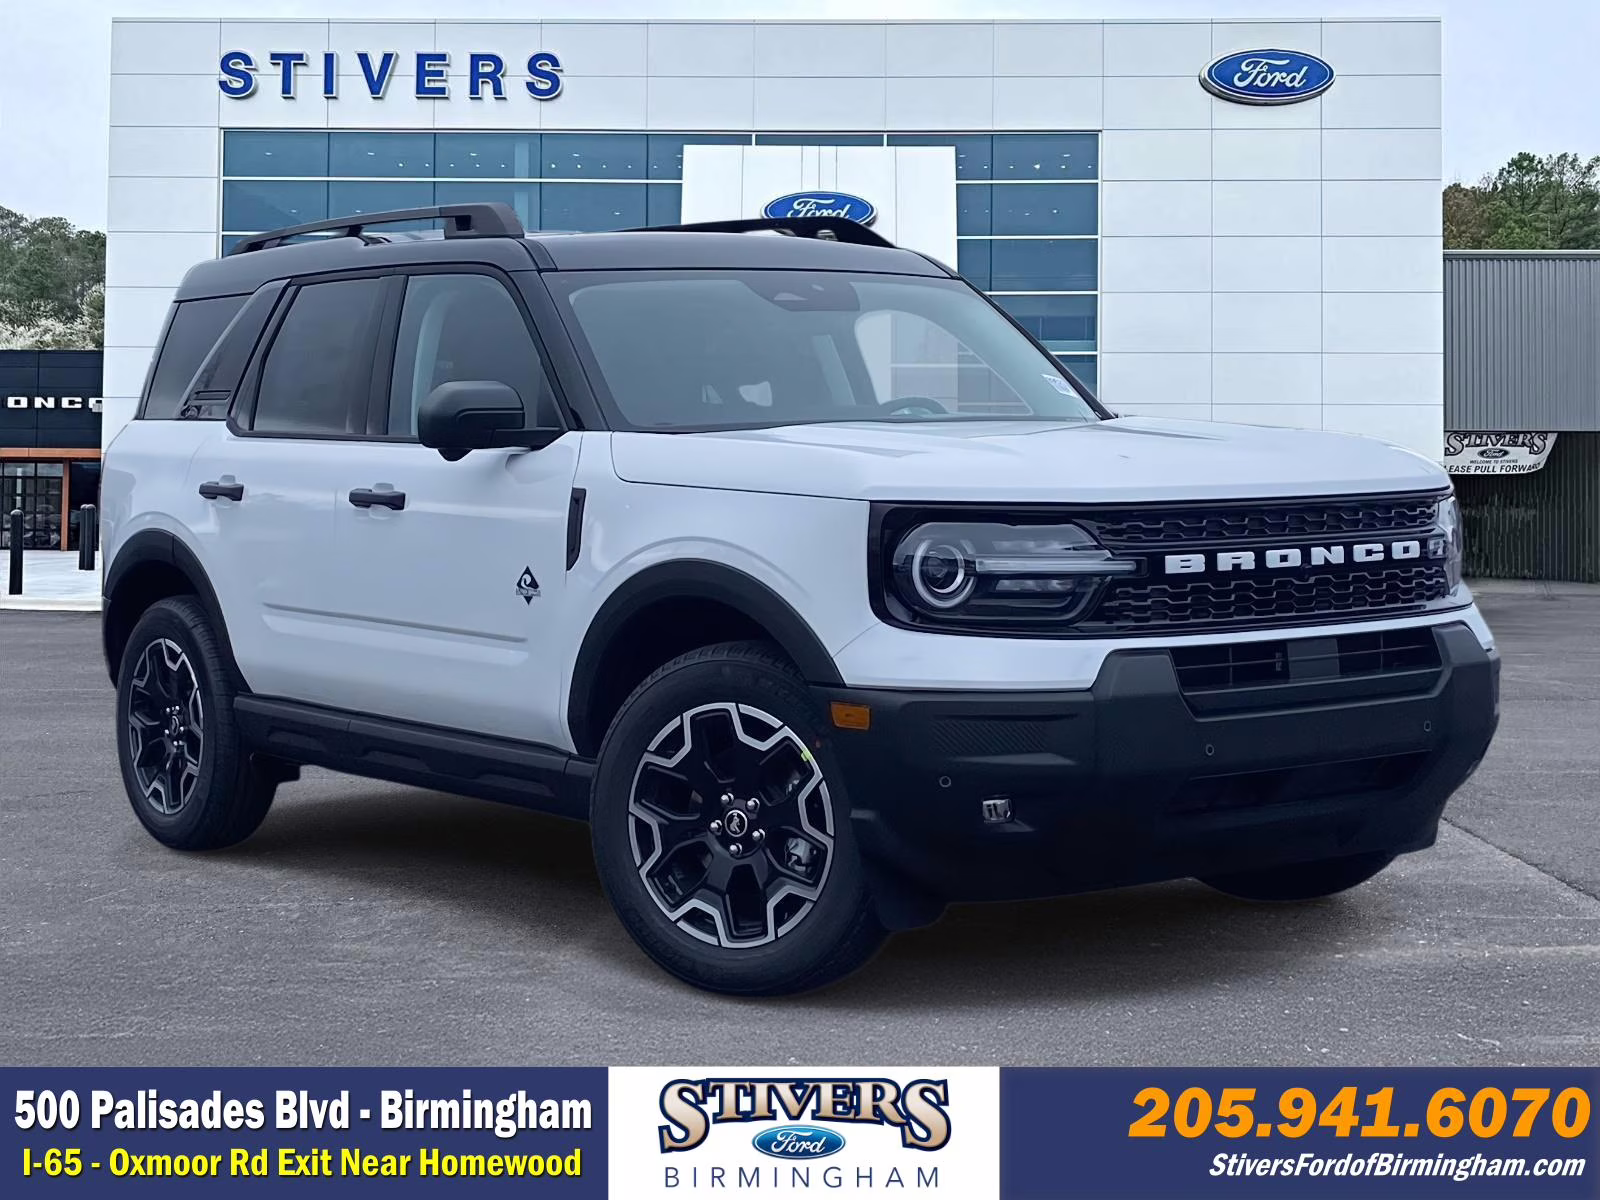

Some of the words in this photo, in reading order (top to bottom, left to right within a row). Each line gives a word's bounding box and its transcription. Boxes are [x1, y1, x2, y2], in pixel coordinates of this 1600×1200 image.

[219, 51, 563, 99] STIVERS
[1233, 58, 1309, 88] Ford
[787, 198, 851, 218] Ford
[1444, 432, 1548, 456] STIVERS
[1483, 448, 1505, 458] Ford
[1474, 465, 1496, 473] PULL
[1164, 540, 1421, 574] BRONCO
